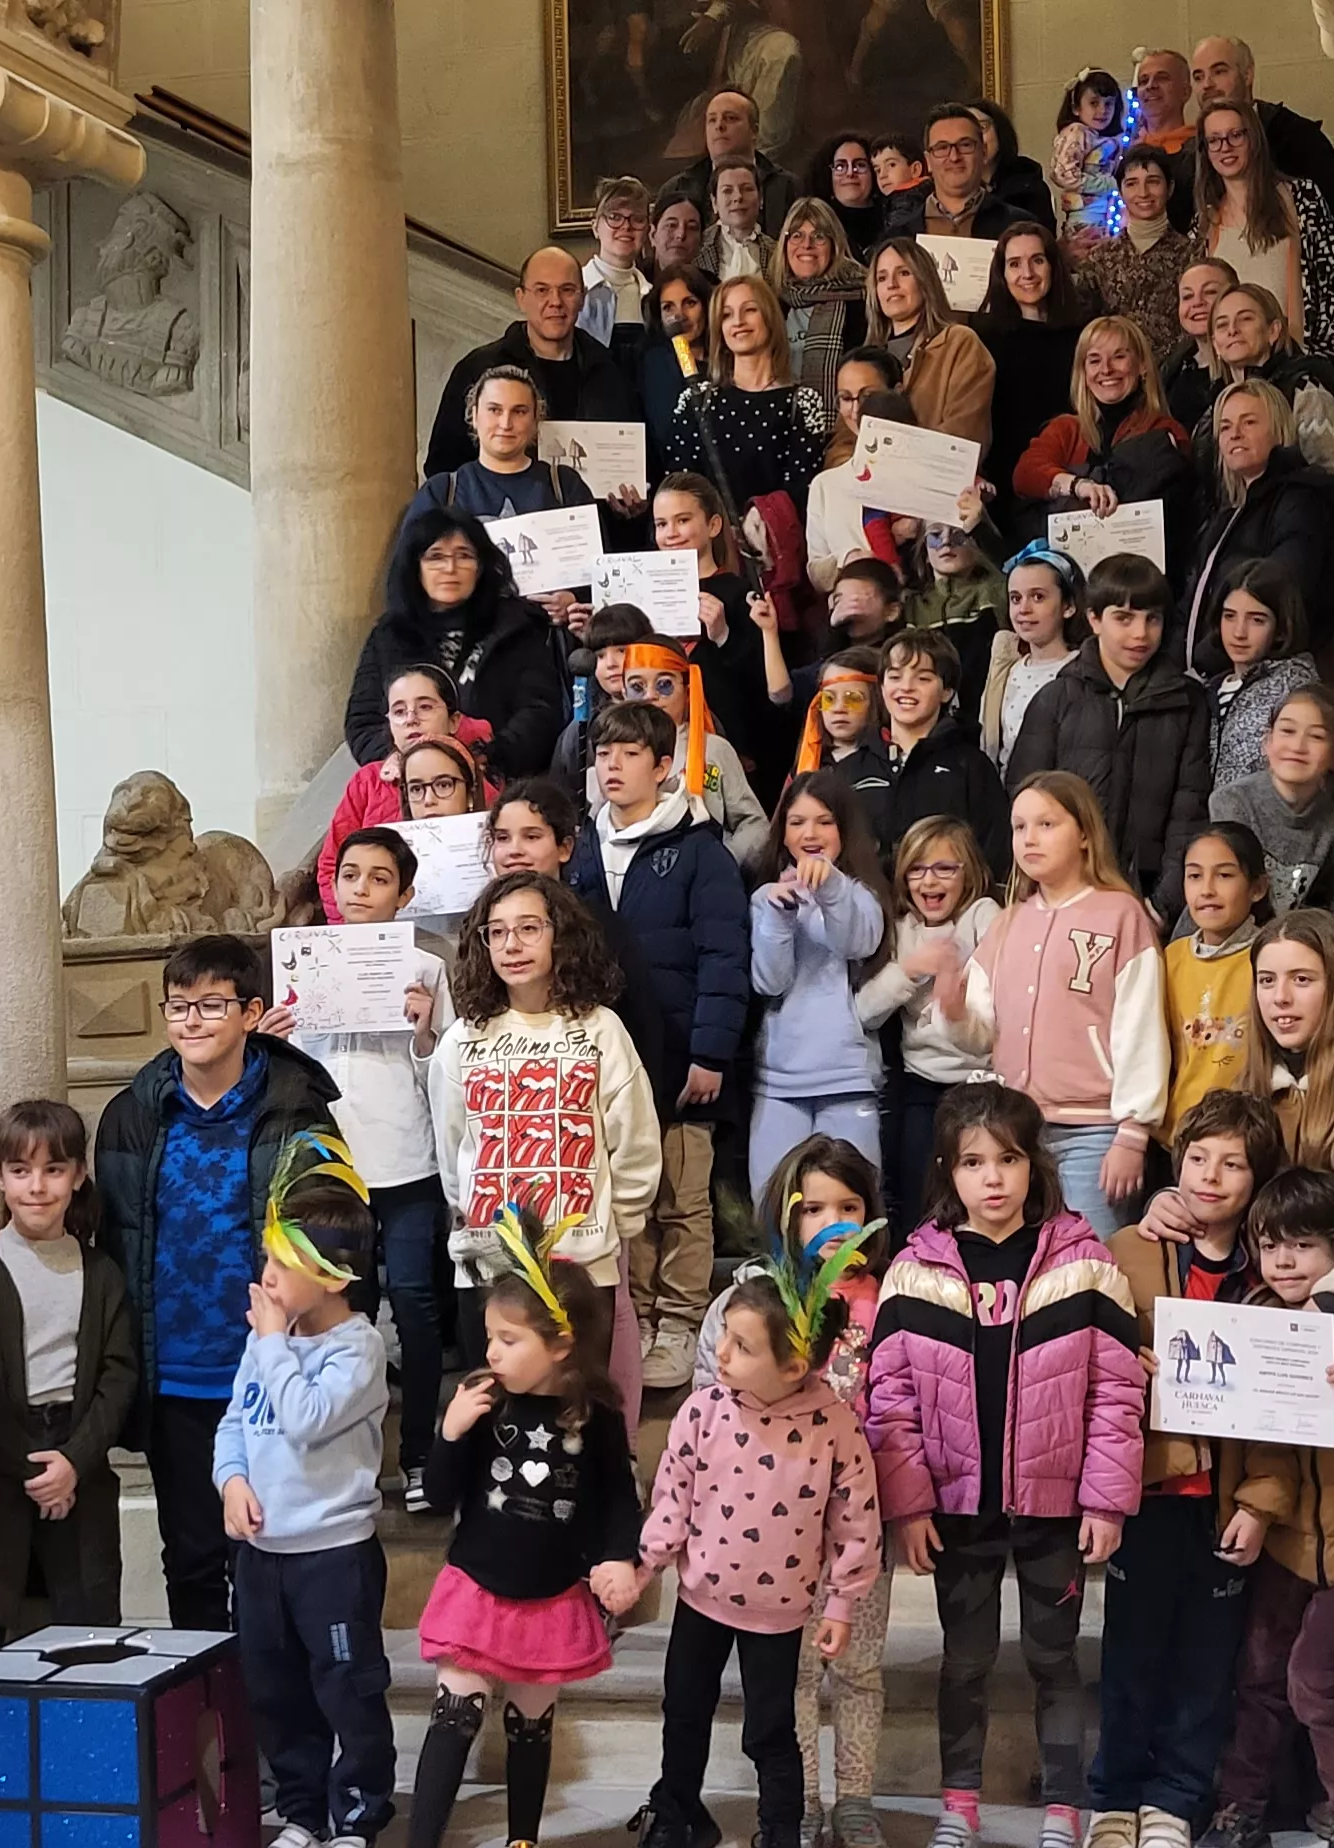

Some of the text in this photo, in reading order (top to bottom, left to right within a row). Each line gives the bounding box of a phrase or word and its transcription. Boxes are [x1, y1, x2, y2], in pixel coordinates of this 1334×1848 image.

[1068, 928, 1116, 994] Y
[458, 1029, 604, 1065] The Rolling Ston
